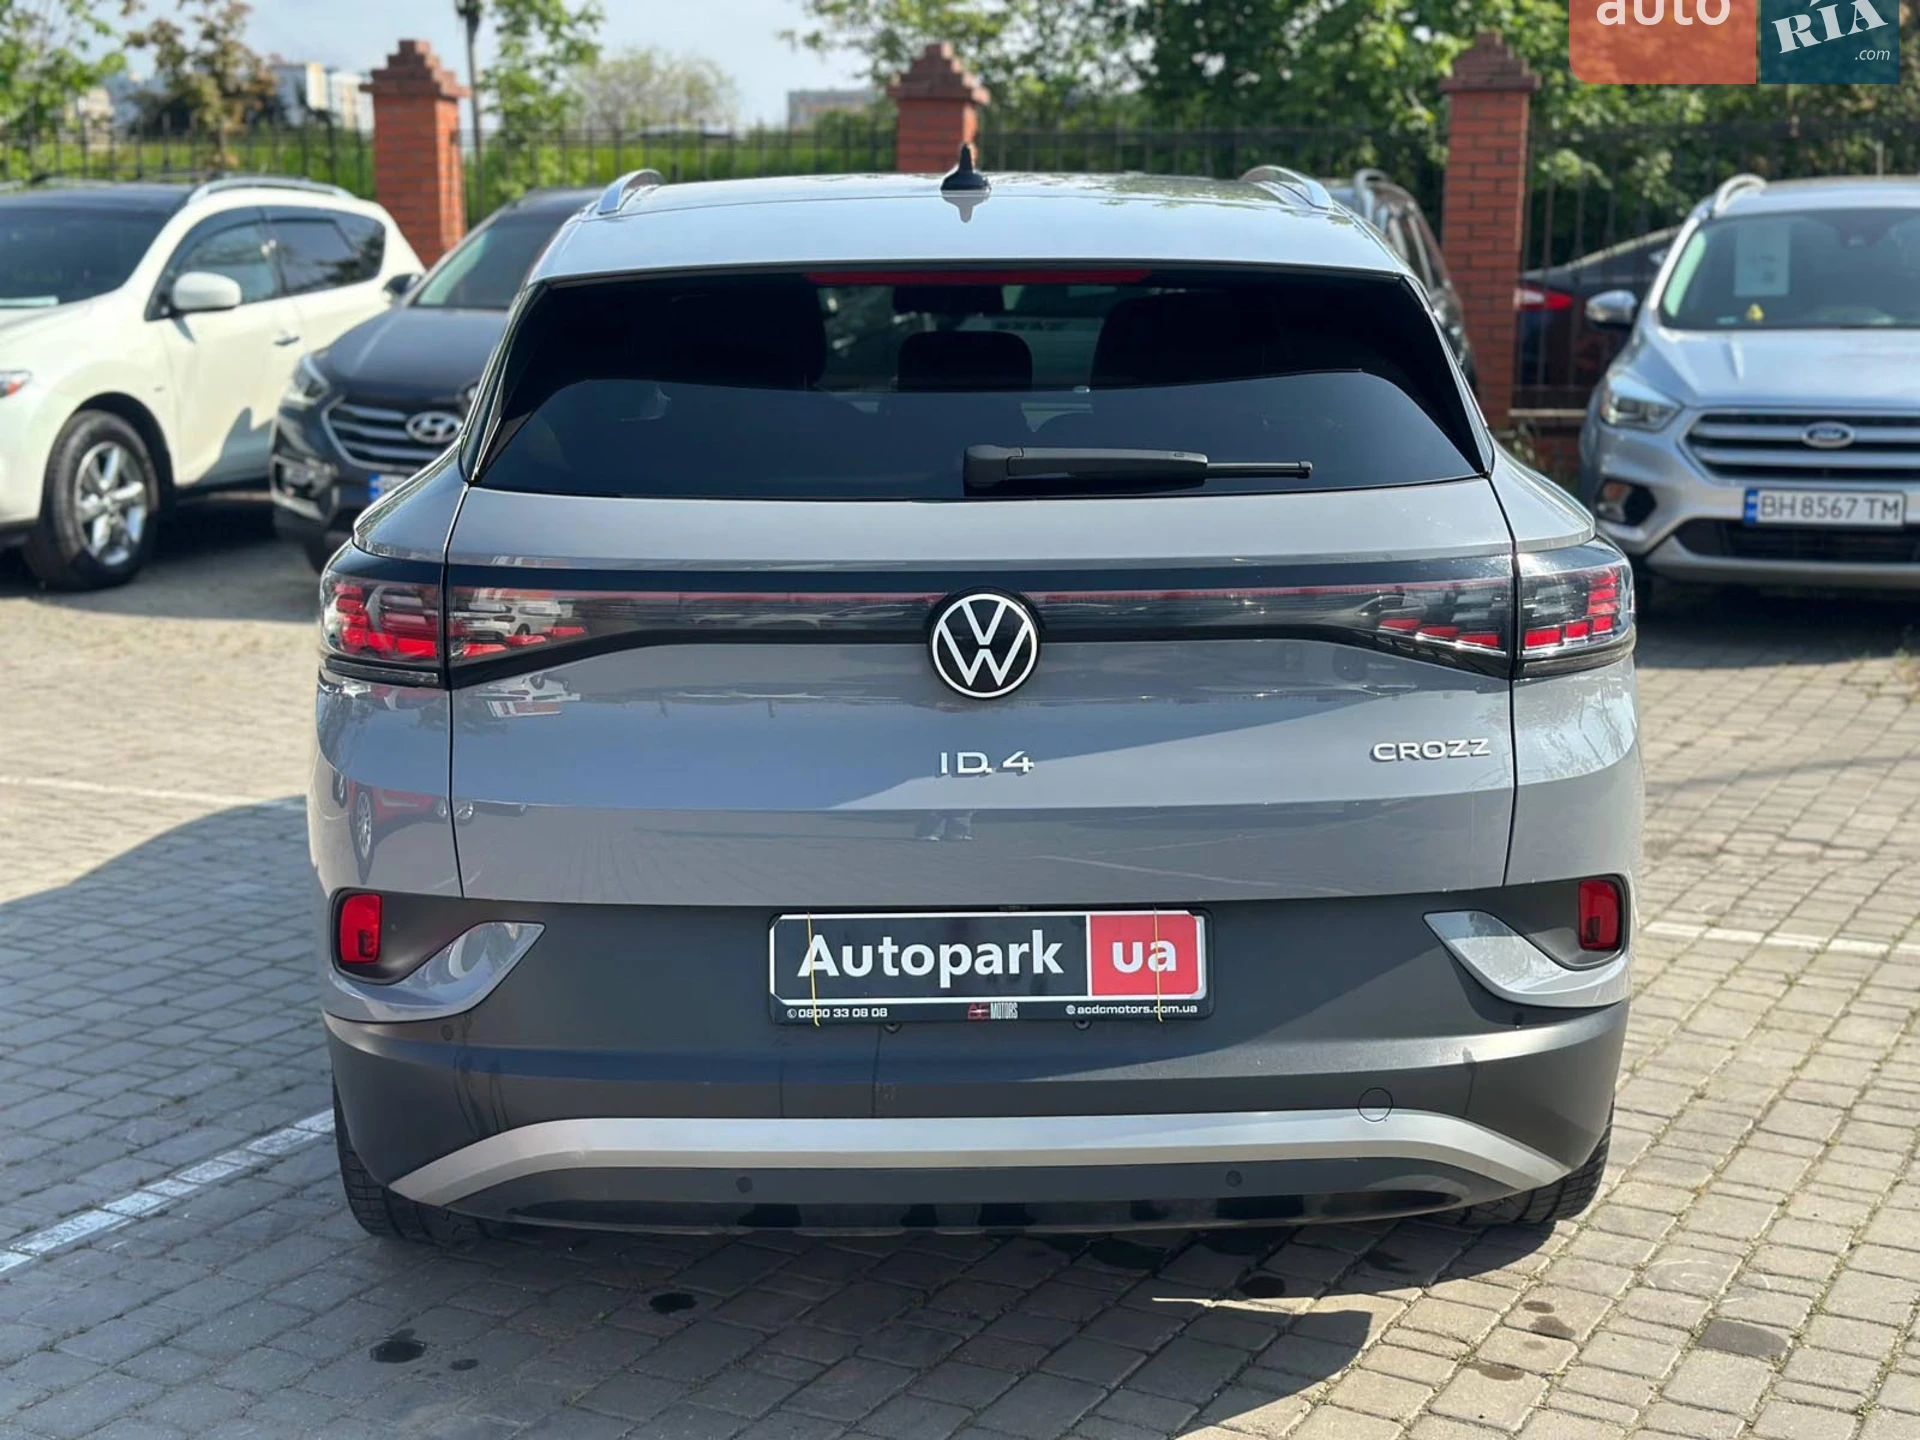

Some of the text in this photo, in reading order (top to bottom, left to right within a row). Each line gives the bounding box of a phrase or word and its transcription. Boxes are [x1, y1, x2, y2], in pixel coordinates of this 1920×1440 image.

[1760, 495, 1796, 518] BH
[1800, 497, 1858, 519] 8567
[1866, 498, 1900, 520] TM
[1372, 738, 1492, 761] CROZZ
[940, 750, 1035, 774] ID.4
[797, 929, 1177, 988] Autopark ua
[798, 1007, 888, 1018] 0800 33 08 08
[1077, 1004, 1198, 1015] acdcmotors.com.ua
